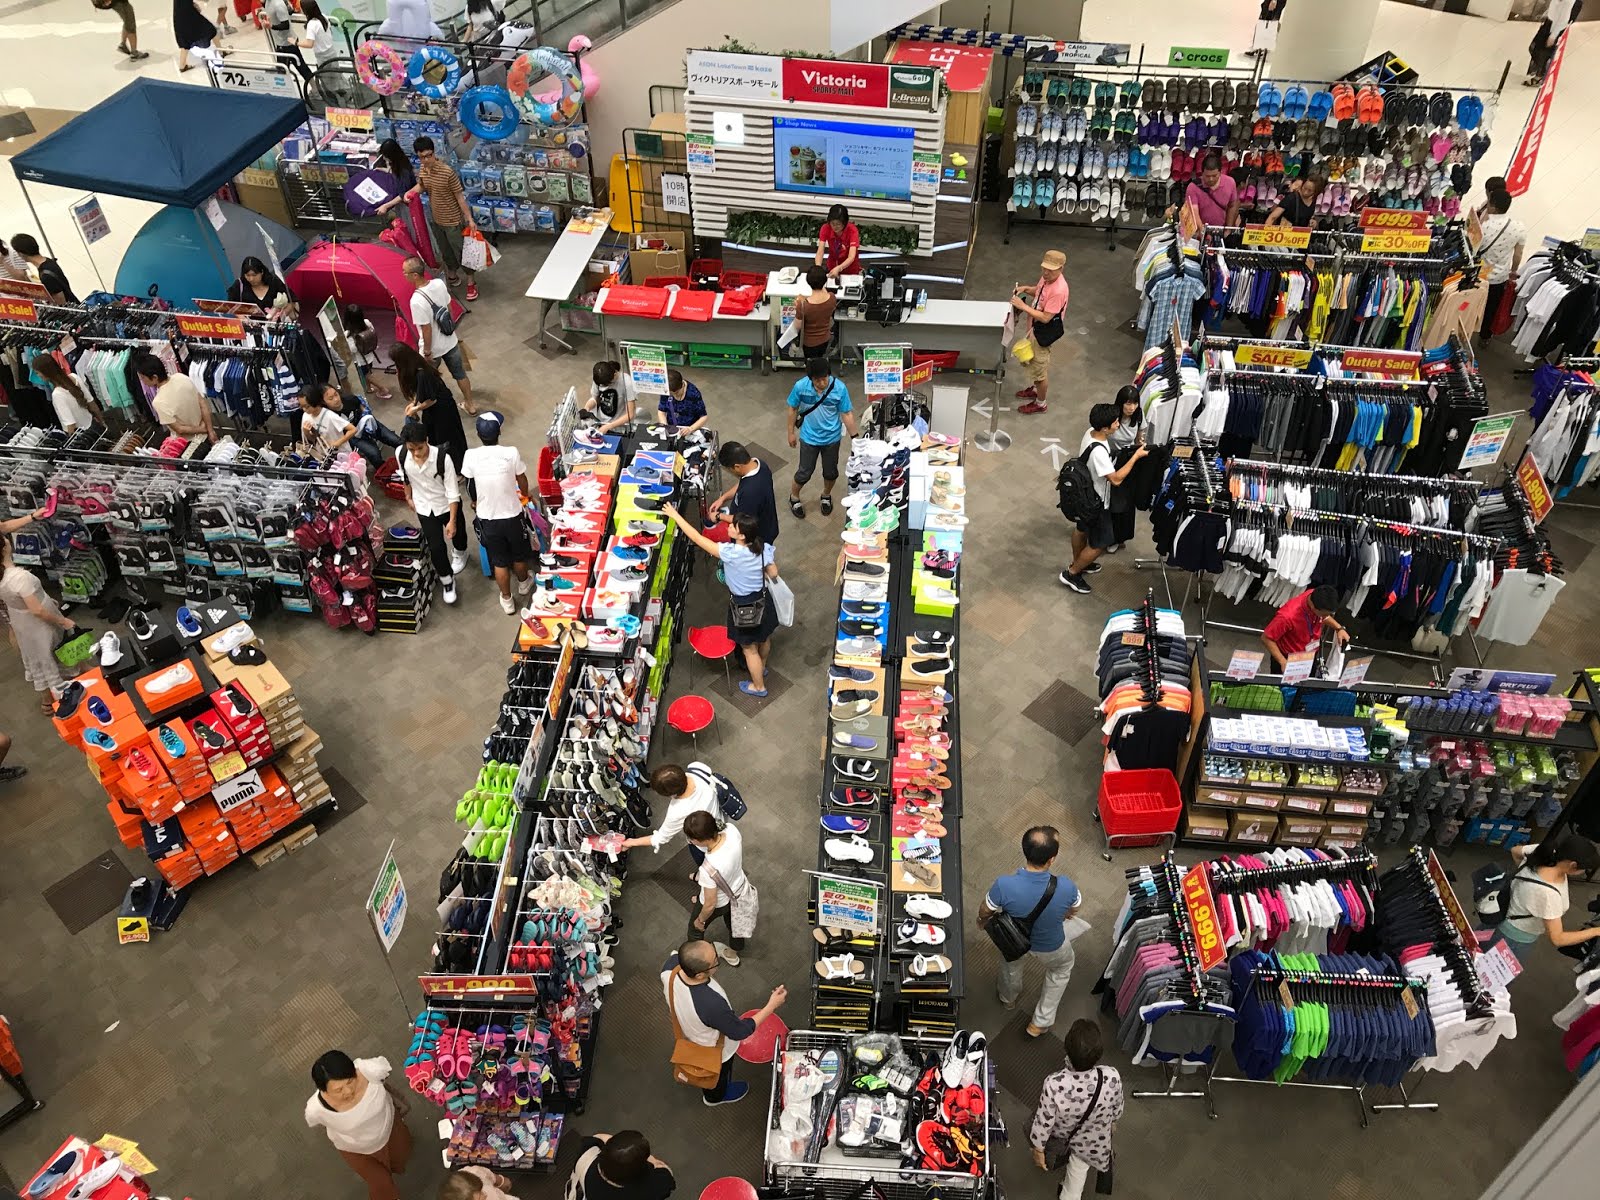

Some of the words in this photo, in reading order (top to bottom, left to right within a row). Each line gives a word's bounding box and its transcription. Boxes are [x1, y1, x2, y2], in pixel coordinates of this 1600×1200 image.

[1186, 53, 1224, 62] crocs
[690, 74, 778, 89] ヴィクトリアスポーツモール
[801, 70, 867, 89] Victoria
[812, 86, 837, 94] SPORTS
[838, 88, 855, 96] MALL
[666, 182, 685, 192] 10時
[666, 195, 686, 207] 開店
[622, 299, 648, 307] Victoria
[8, 304, 34, 316] Sale!
[181, 320, 214, 332] Outlet
[215, 324, 242, 334] Sale!
[1251, 353, 1295, 366] SALE
[1345, 356, 1382, 368] Outlet
[1385, 359, 1416, 370] Sale!
[904, 367, 929, 384] Sale!
[220, 786, 255, 809] PUMA
[836, 882, 861, 890] Victoria
[823, 891, 845, 900] 夏の
[822, 898, 873, 912] スポーツ祭り
[1501, 950, 1521, 974] Sale!
